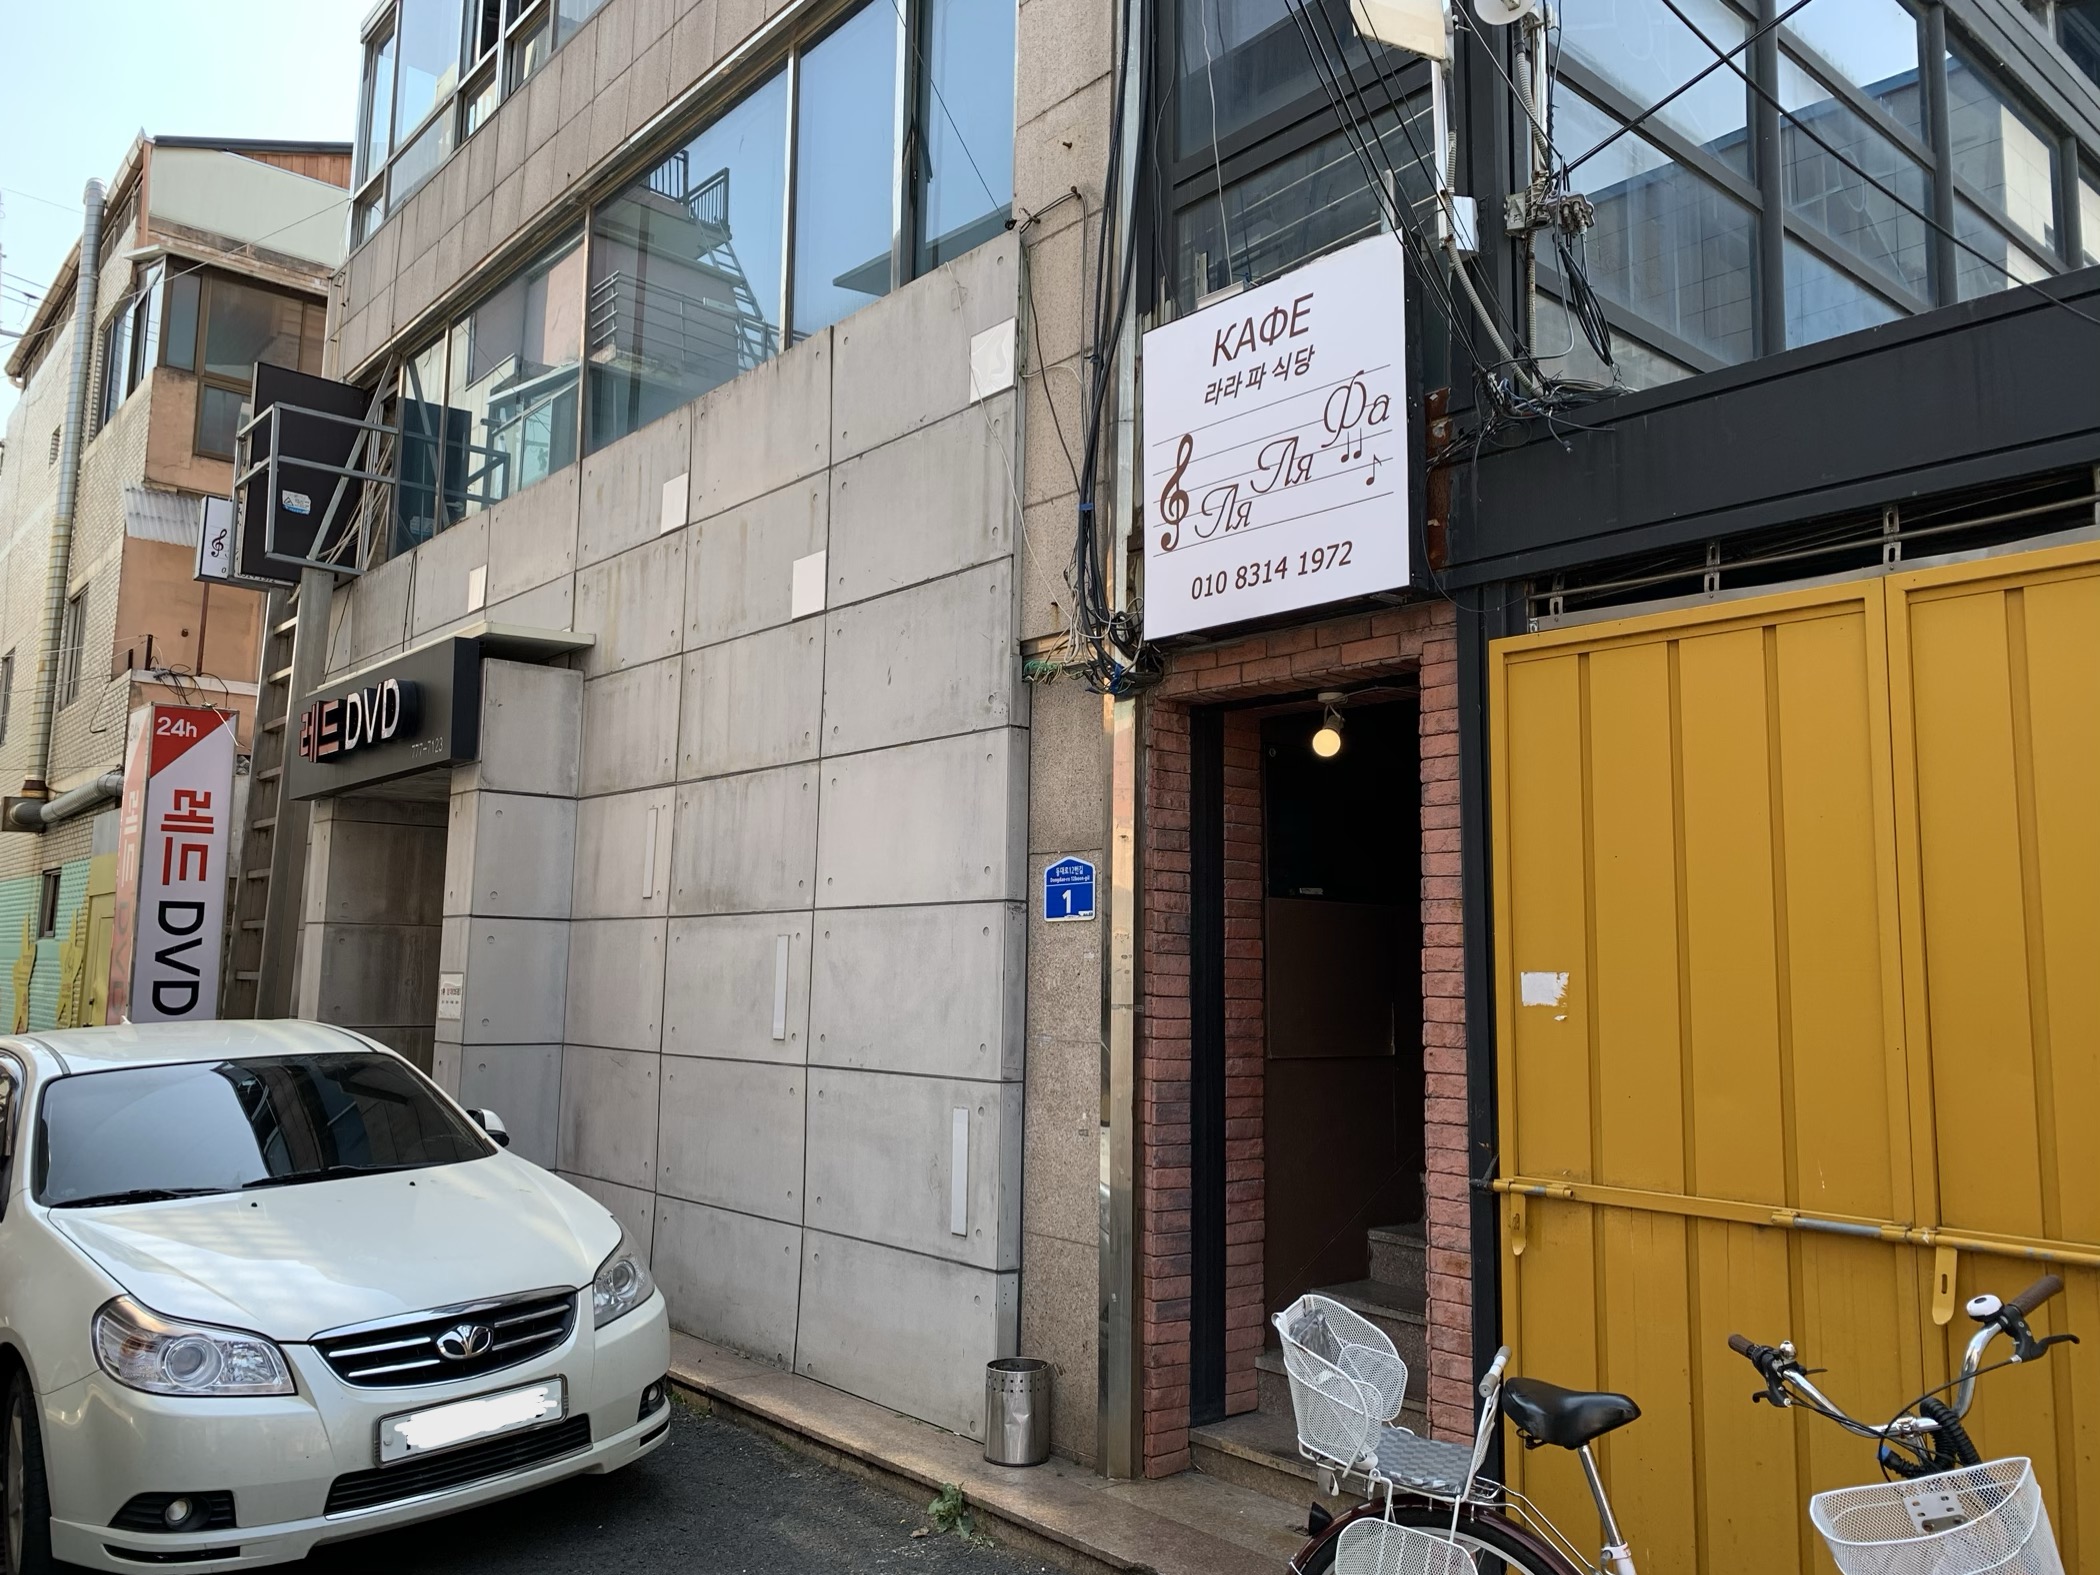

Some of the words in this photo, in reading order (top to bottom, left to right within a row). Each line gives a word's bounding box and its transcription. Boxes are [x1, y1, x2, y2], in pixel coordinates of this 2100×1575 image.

[1212, 292, 1314, 367] КАФЕ
[1204, 362, 1267, 405] 라라파
[1272, 344, 1315, 382] 식당
[1194, 483, 1252, 538] Ля
[1250, 436, 1314, 493] Ля
[1320, 370, 1390, 448] Фа
[1191, 570, 1228, 600] 010
[1234, 556, 1288, 590] 8314
[1297, 538, 1353, 576] 1972
[156, 716, 197, 738] 24h
[299, 699, 339, 763] 레드
[344, 678, 401, 750] DVD
[410, 736, 444, 759] 777-7123
[160, 789, 215, 886] 레드
[1062, 889, 1072, 914] 1
[151, 900, 206, 1016] DVD
